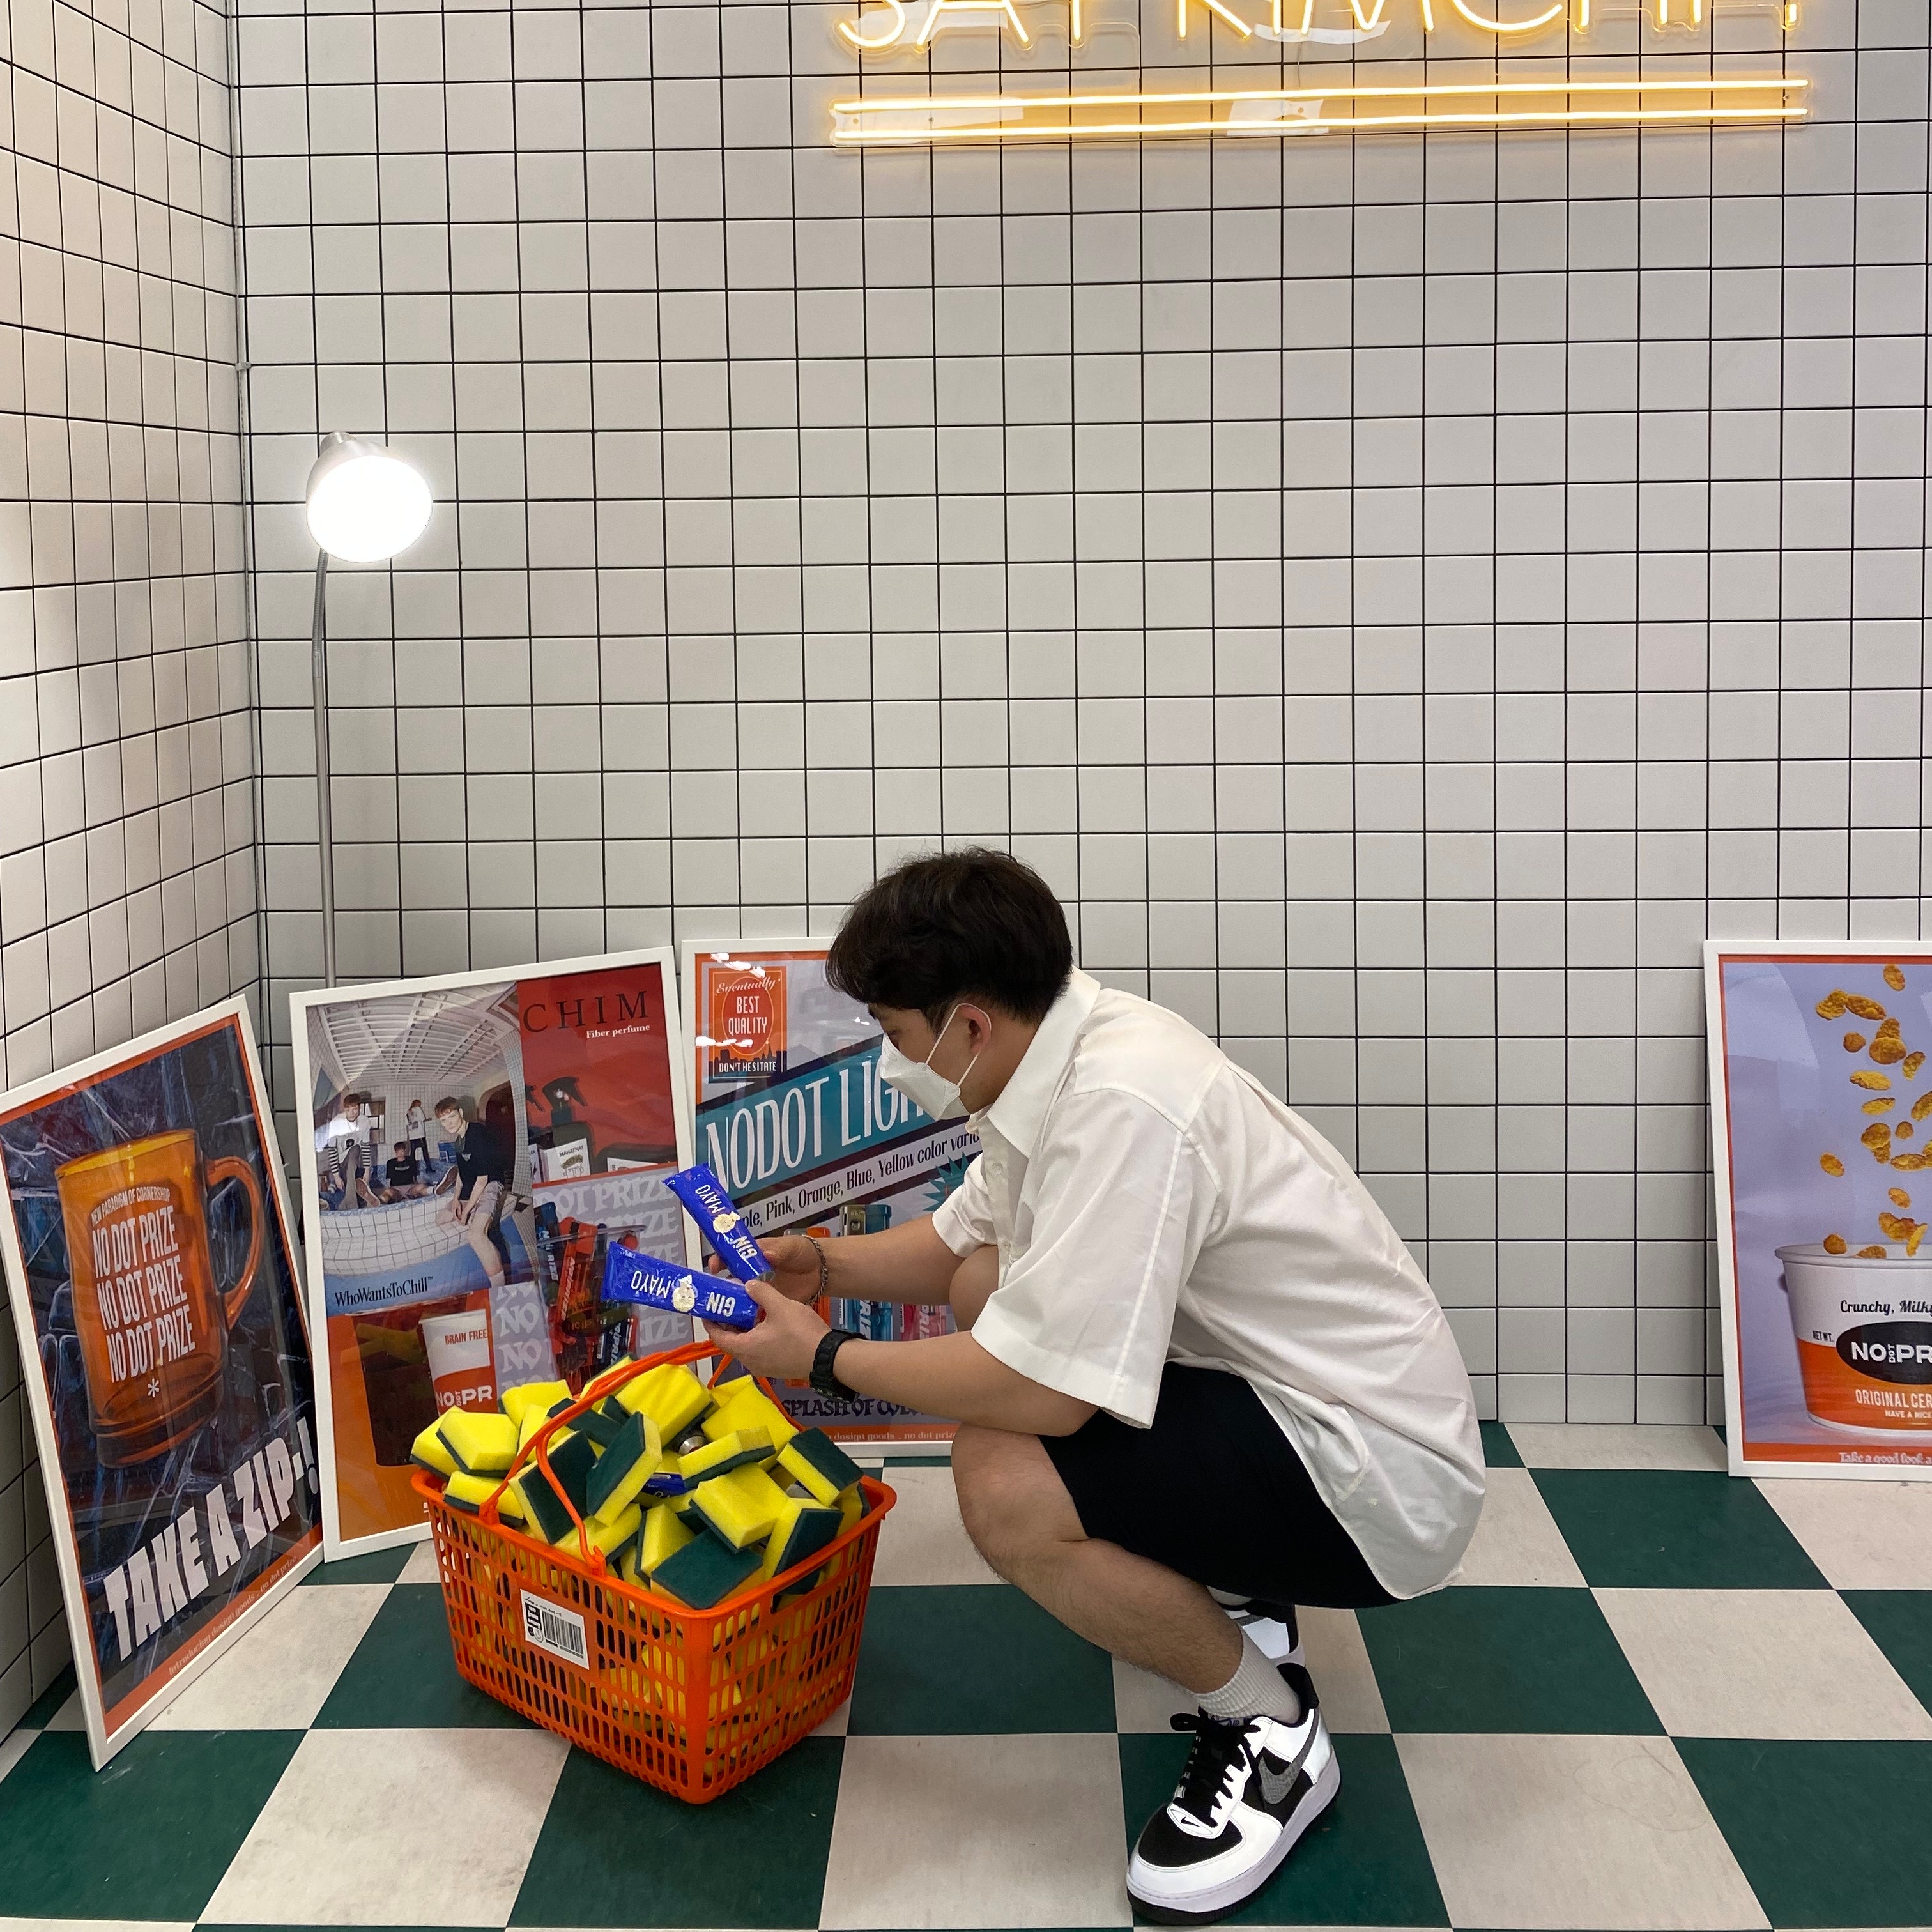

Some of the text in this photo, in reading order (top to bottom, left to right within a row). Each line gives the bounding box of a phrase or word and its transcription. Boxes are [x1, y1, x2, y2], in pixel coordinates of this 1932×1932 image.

[523, 991, 648, 1032] CHIM
[737, 996, 760, 1014] BEST
[586, 1024, 650, 1039] Fiber perfume
[728, 1017, 767, 1036] QUALITY
[719, 1061, 777, 1073] DON'T HESITATE
[706, 1076, 829, 1193] NODOT
[766, 1196, 795, 1221] Pink,
[799, 1181, 843, 1208] Orange,
[847, 1169, 875, 1190] Blue,
[878, 1151, 914, 1178] Yellow
[917, 1140, 947, 1163] color
[695, 1184, 726, 1213] MAYO
[93, 1205, 178, 1278] NO DOT PRIZE
[97, 1254, 188, 1330] NO DOT PRIZE
[631, 1271, 735, 1317] GIN MAYO
[496, 1302, 539, 1337] NO
[1841, 1300, 1894, 1316] Crunchy,
[106, 1304, 195, 1383] NO DOT PRIZE
[445, 1329, 487, 1345] BRAIN FREE
[1812, 1330, 1822, 1340] NET
[498, 1338, 542, 1373] NO
[1851, 1342, 1887, 1362] NO
[781, 1399, 850, 1417] SPLASH
[851, 1399, 875, 1417] OF
[1855, 1388, 1909, 1408] ORIGINAL
[834, 1433, 865, 1441] design
[867, 1432, 894, 1441] goods
[918, 1432, 932, 1440] dot
[103, 1506, 209, 1662] TAKE
[206, 1483, 241, 1577] A
[168, 1556, 298, 1676] Introducing design goods no dot prize
